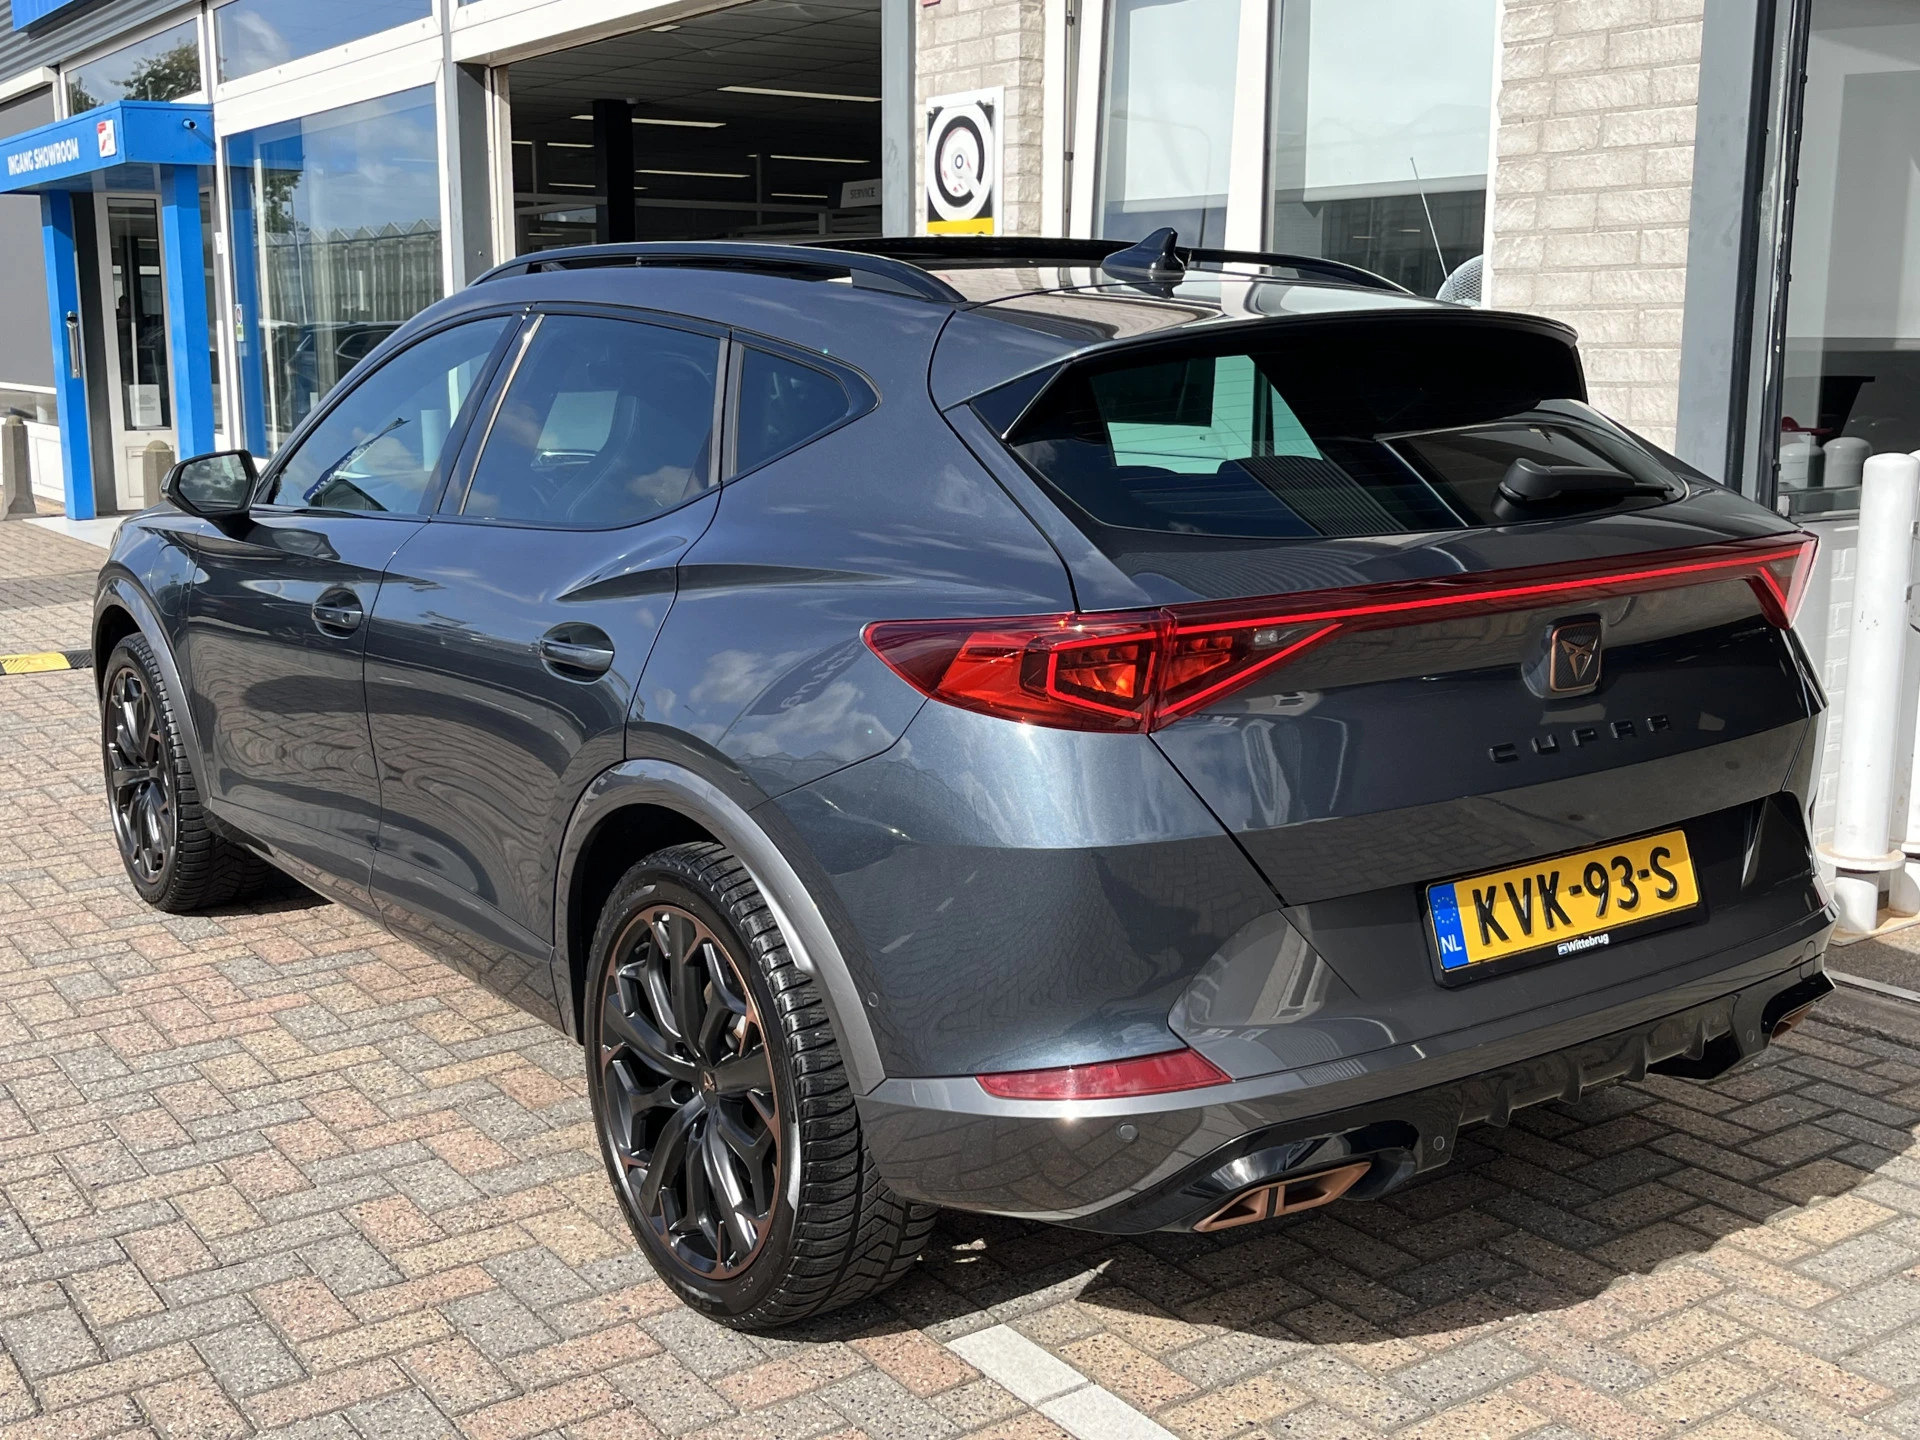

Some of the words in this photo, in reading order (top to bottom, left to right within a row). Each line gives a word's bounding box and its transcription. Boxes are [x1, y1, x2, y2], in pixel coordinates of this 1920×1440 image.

[7, 149, 34, 176] INGANG
[34, 137, 79, 170] SHOWROOM
[850, 187, 875, 199] SERVICE
[1489, 714, 1672, 763] CUPRA
[1472, 846, 1678, 946] KVK-93-S
[1440, 933, 1462, 954] NL
[1567, 933, 1609, 952] Wittebrug
